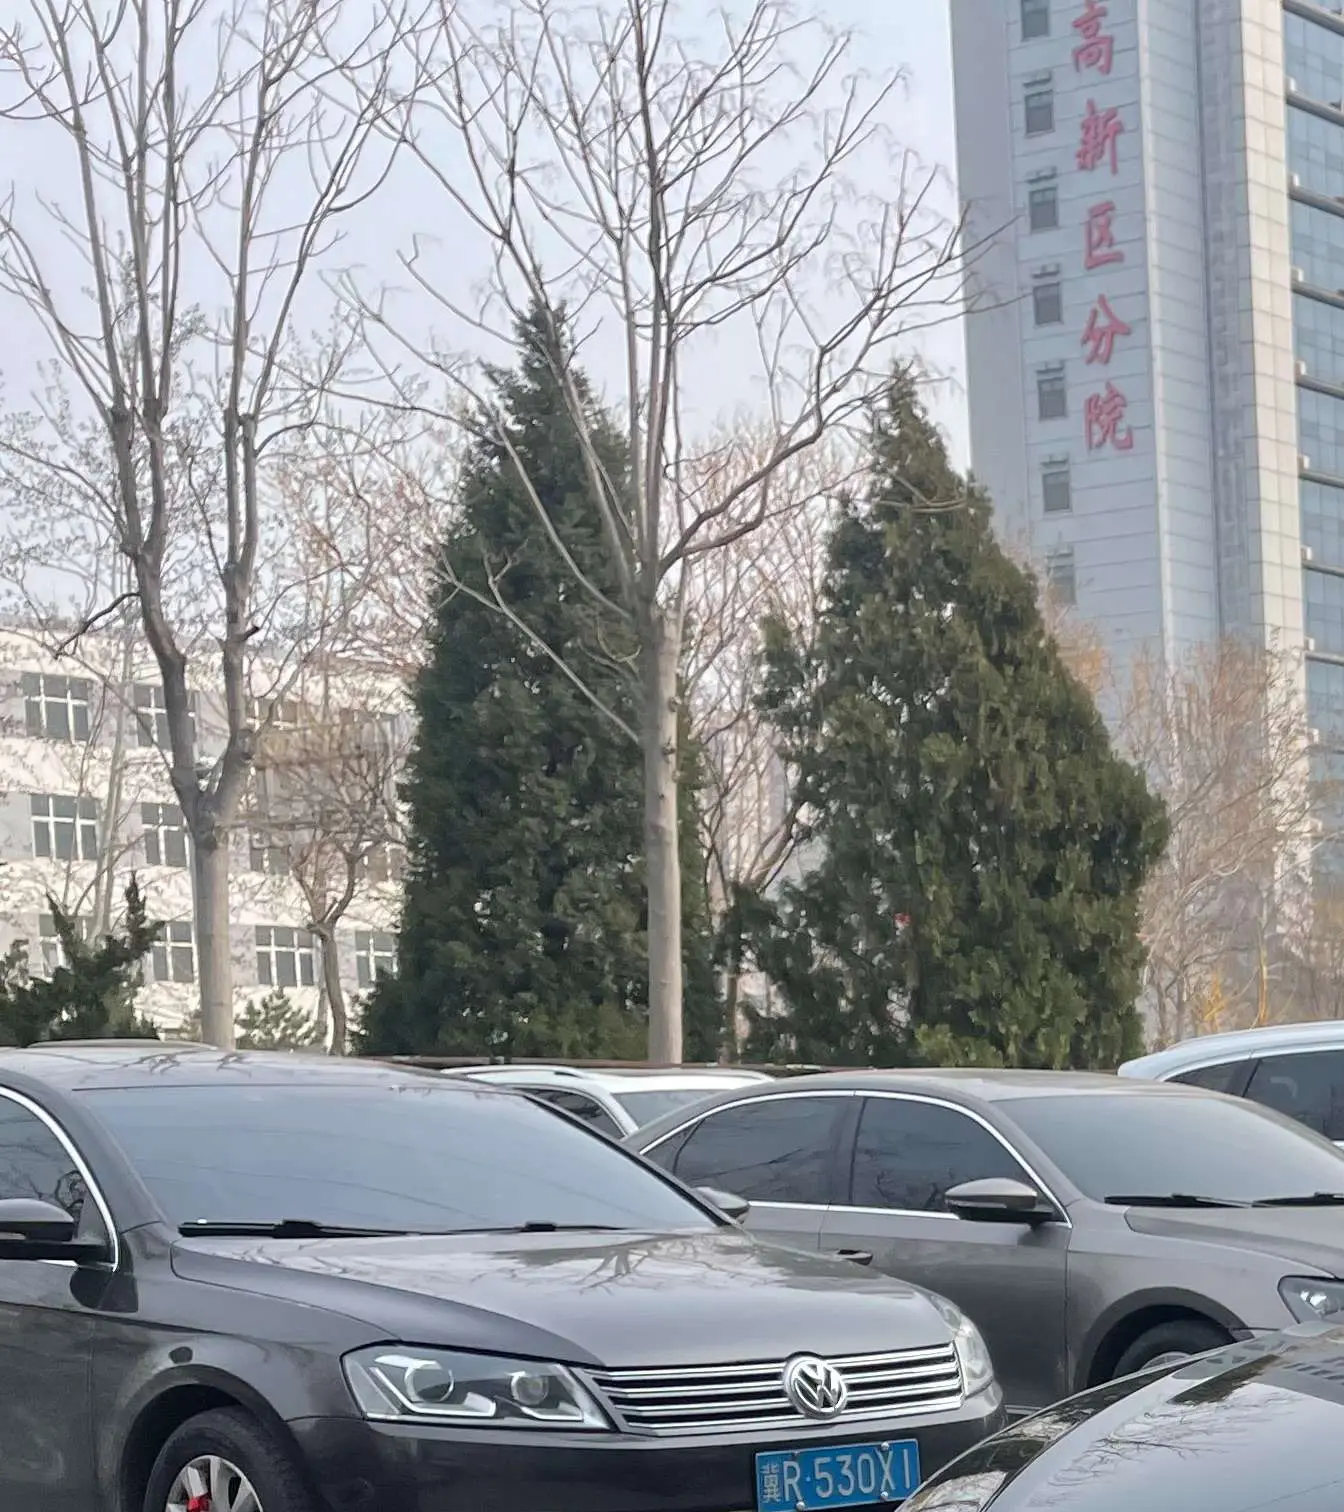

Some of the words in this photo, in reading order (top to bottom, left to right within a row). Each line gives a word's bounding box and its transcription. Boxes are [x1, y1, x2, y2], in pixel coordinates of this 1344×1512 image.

[1071, 0, 1134, 452] 高新区分院
